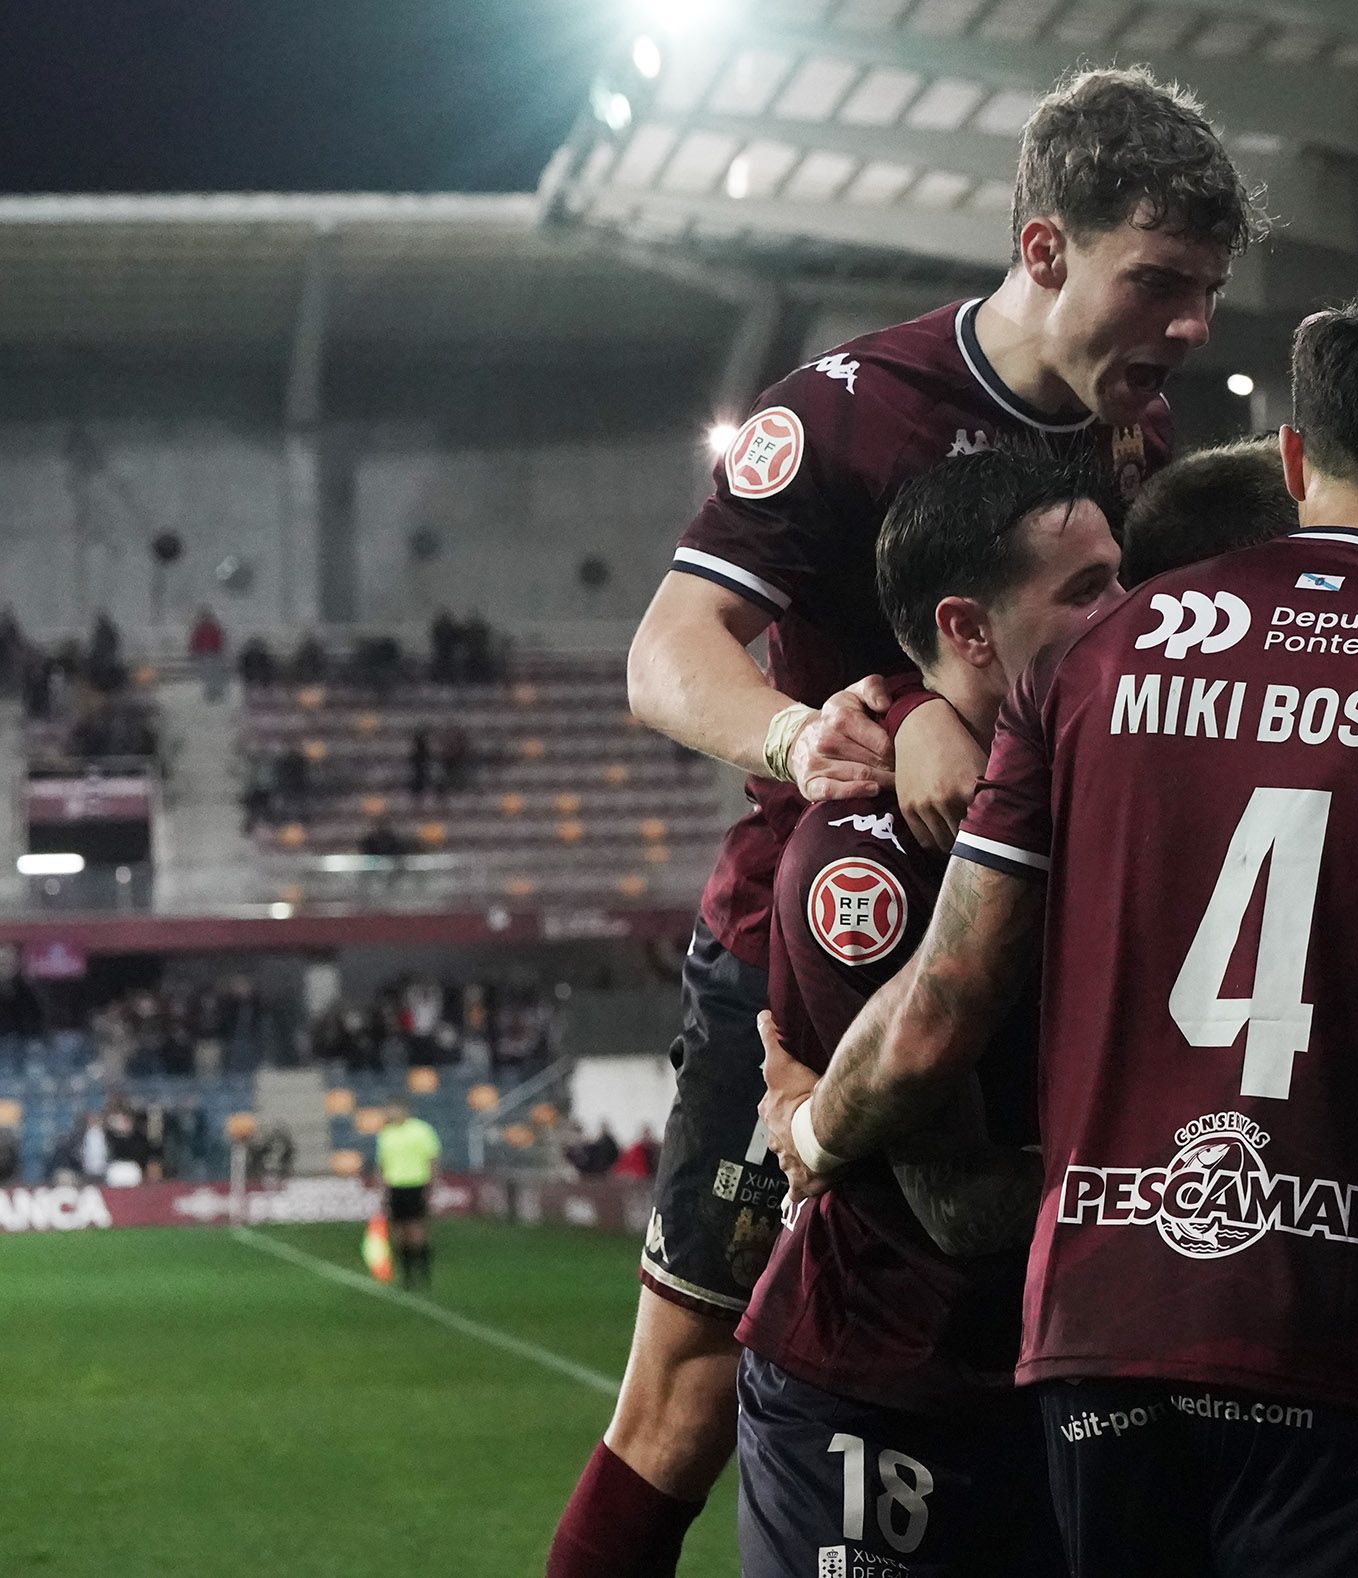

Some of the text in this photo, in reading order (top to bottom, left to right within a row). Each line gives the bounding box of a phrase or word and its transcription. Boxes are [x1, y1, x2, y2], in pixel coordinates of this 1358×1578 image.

[1110, 674, 1247, 740] MIKI
[1169, 787, 1332, 1100] 4
[740, 1188, 762, 1205] DE
[827, 1433, 934, 1553] 18
